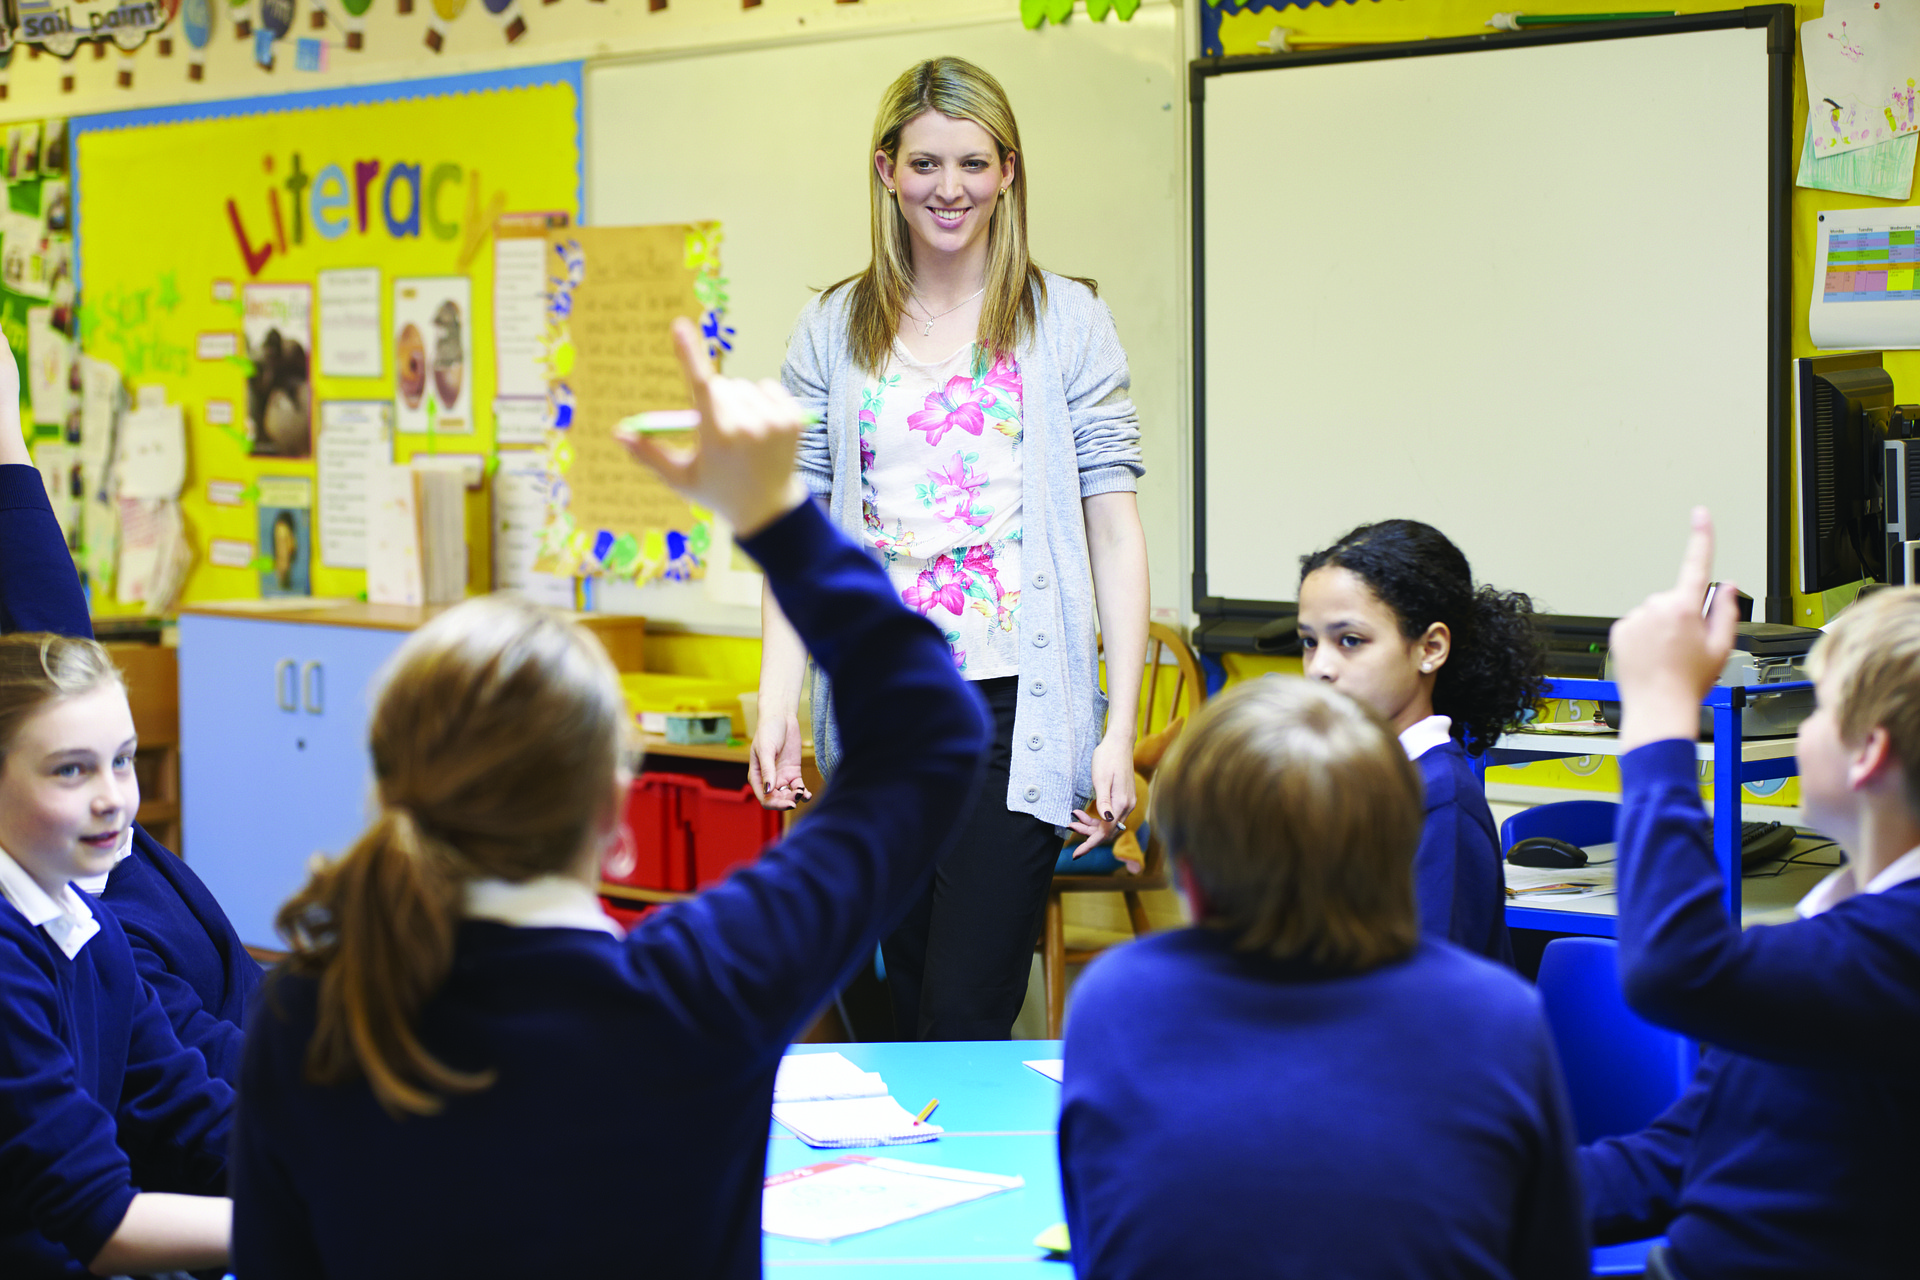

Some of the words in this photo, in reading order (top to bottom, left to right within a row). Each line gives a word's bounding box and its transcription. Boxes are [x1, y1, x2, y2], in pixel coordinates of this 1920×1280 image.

[24, 6, 73, 36] sail
[89, 2, 155, 36] paint
[226, 152, 506, 276] Literacy
[1569, 699, 1581, 721] 5
